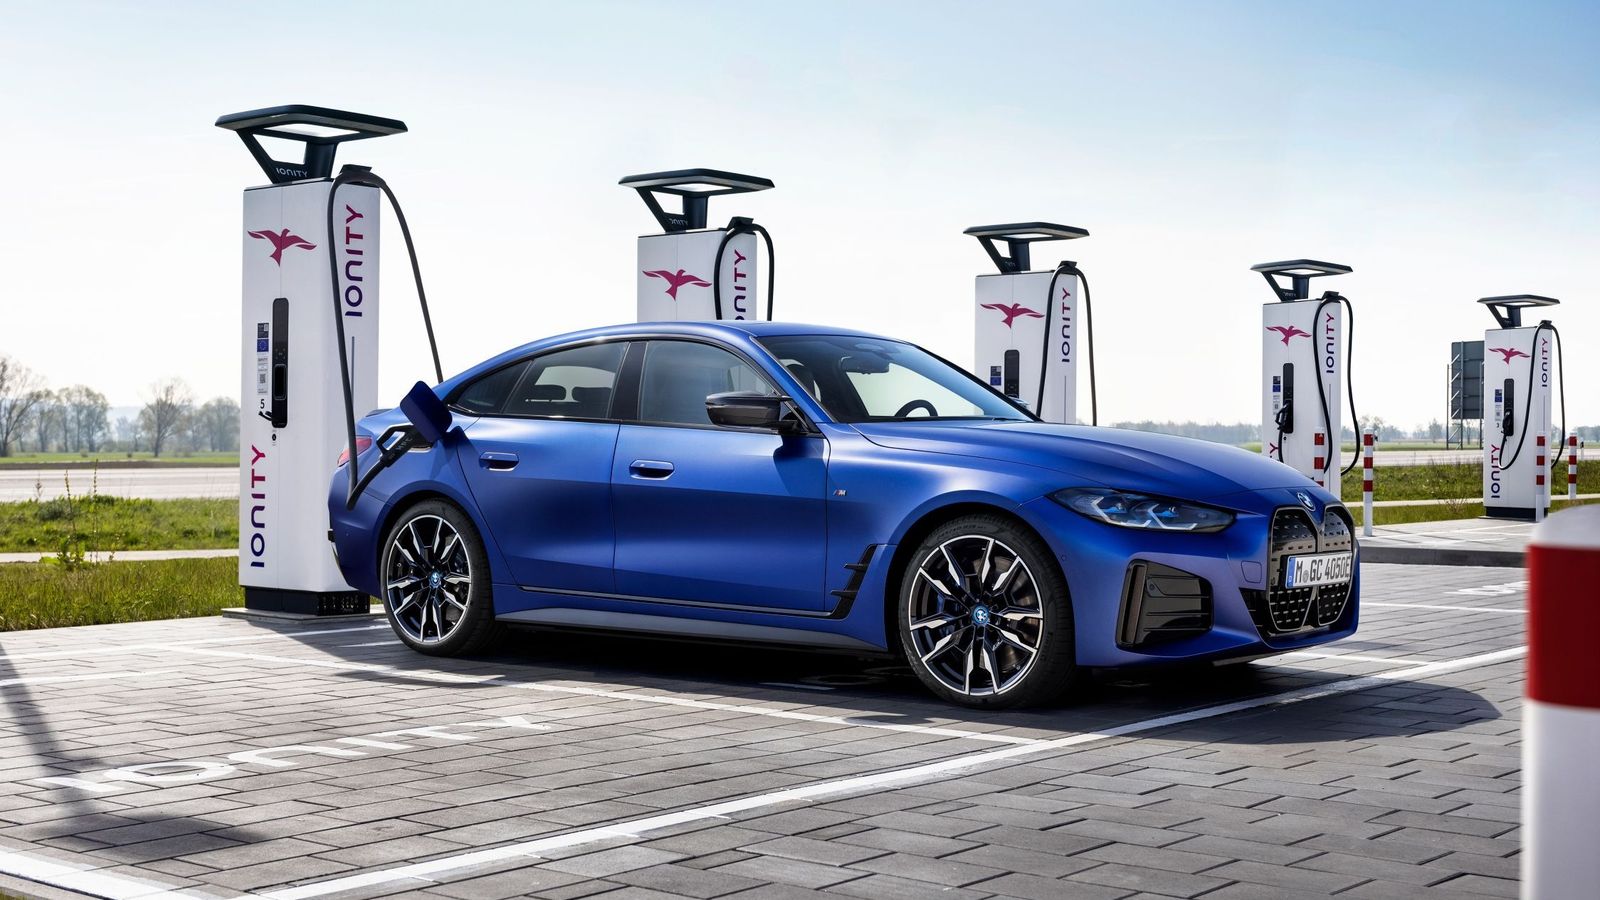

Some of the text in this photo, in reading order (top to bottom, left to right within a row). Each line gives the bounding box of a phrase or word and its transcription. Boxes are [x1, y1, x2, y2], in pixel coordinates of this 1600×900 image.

[276, 167, 308, 178] IONITY
[345, 204, 364, 317] IONITY
[734, 249, 747, 320] NITY
[1062, 287, 1071, 363] IONITY
[1326, 312, 1335, 374] IONITY
[1541, 337, 1549, 388] IONITY
[260, 398, 265, 409] 5
[250, 444, 266, 568] IONITY
[1295, 556, 1350, 583] M GC 4050E
